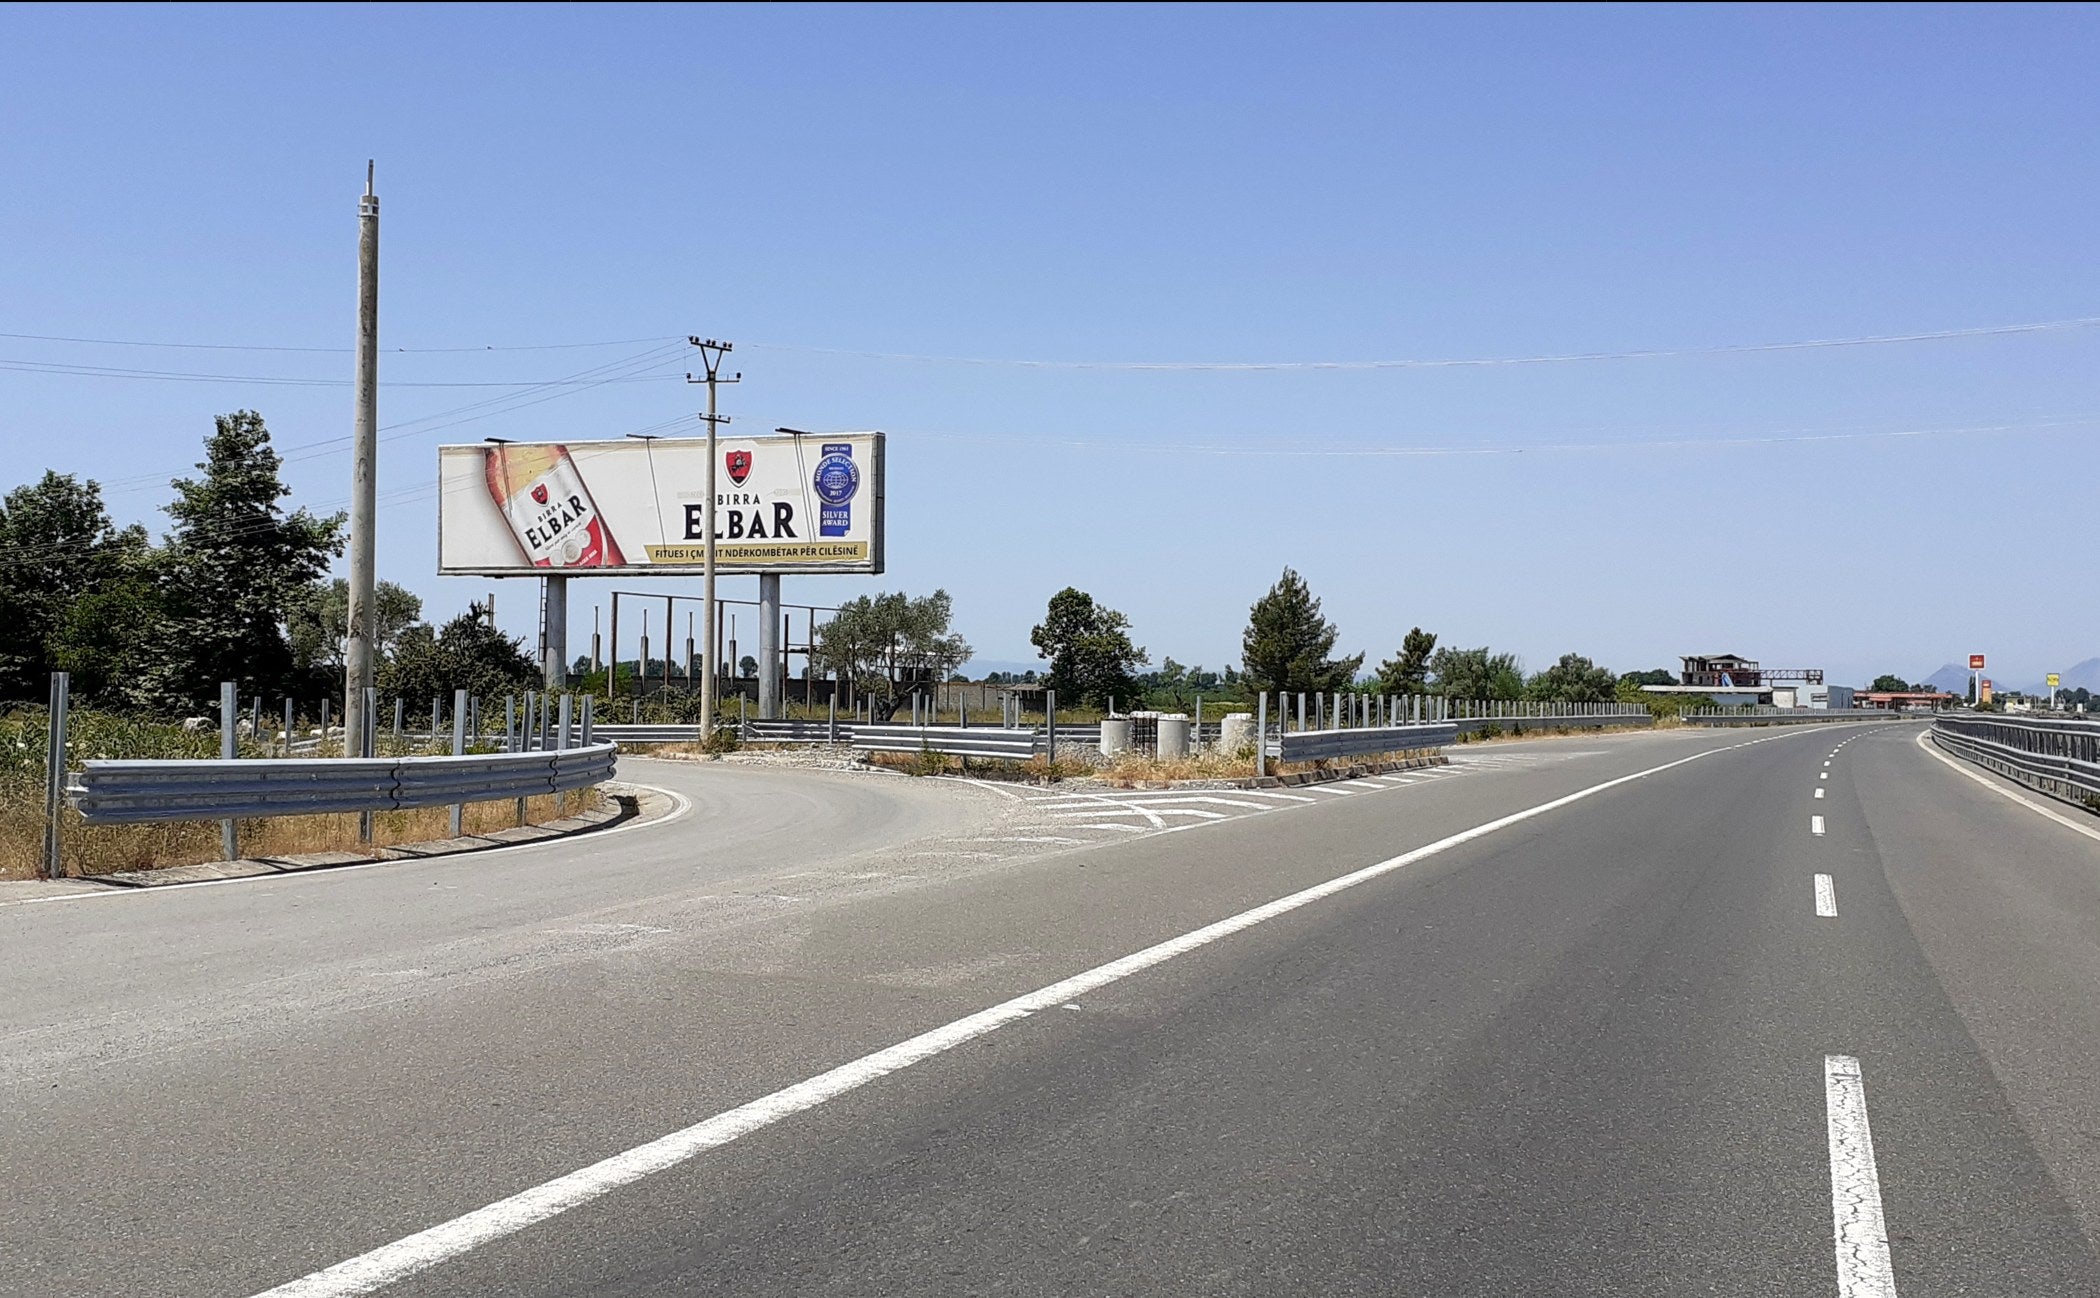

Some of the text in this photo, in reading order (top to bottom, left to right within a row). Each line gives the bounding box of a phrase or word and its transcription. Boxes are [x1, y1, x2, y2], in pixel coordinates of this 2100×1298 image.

[718, 494, 760, 506] BIRRA
[538, 502, 562, 522] BIRRA
[822, 510, 848, 518] SILVER
[524, 494, 588, 550] ELBAR
[656, 550, 684, 558] FITUES
[690, 550, 723, 560] ÇMIT
[725, 546, 798, 558] NDËRKOMBËTAR
[800, 546, 817, 556] PËR
[819, 544, 858, 556] CILËSINË
